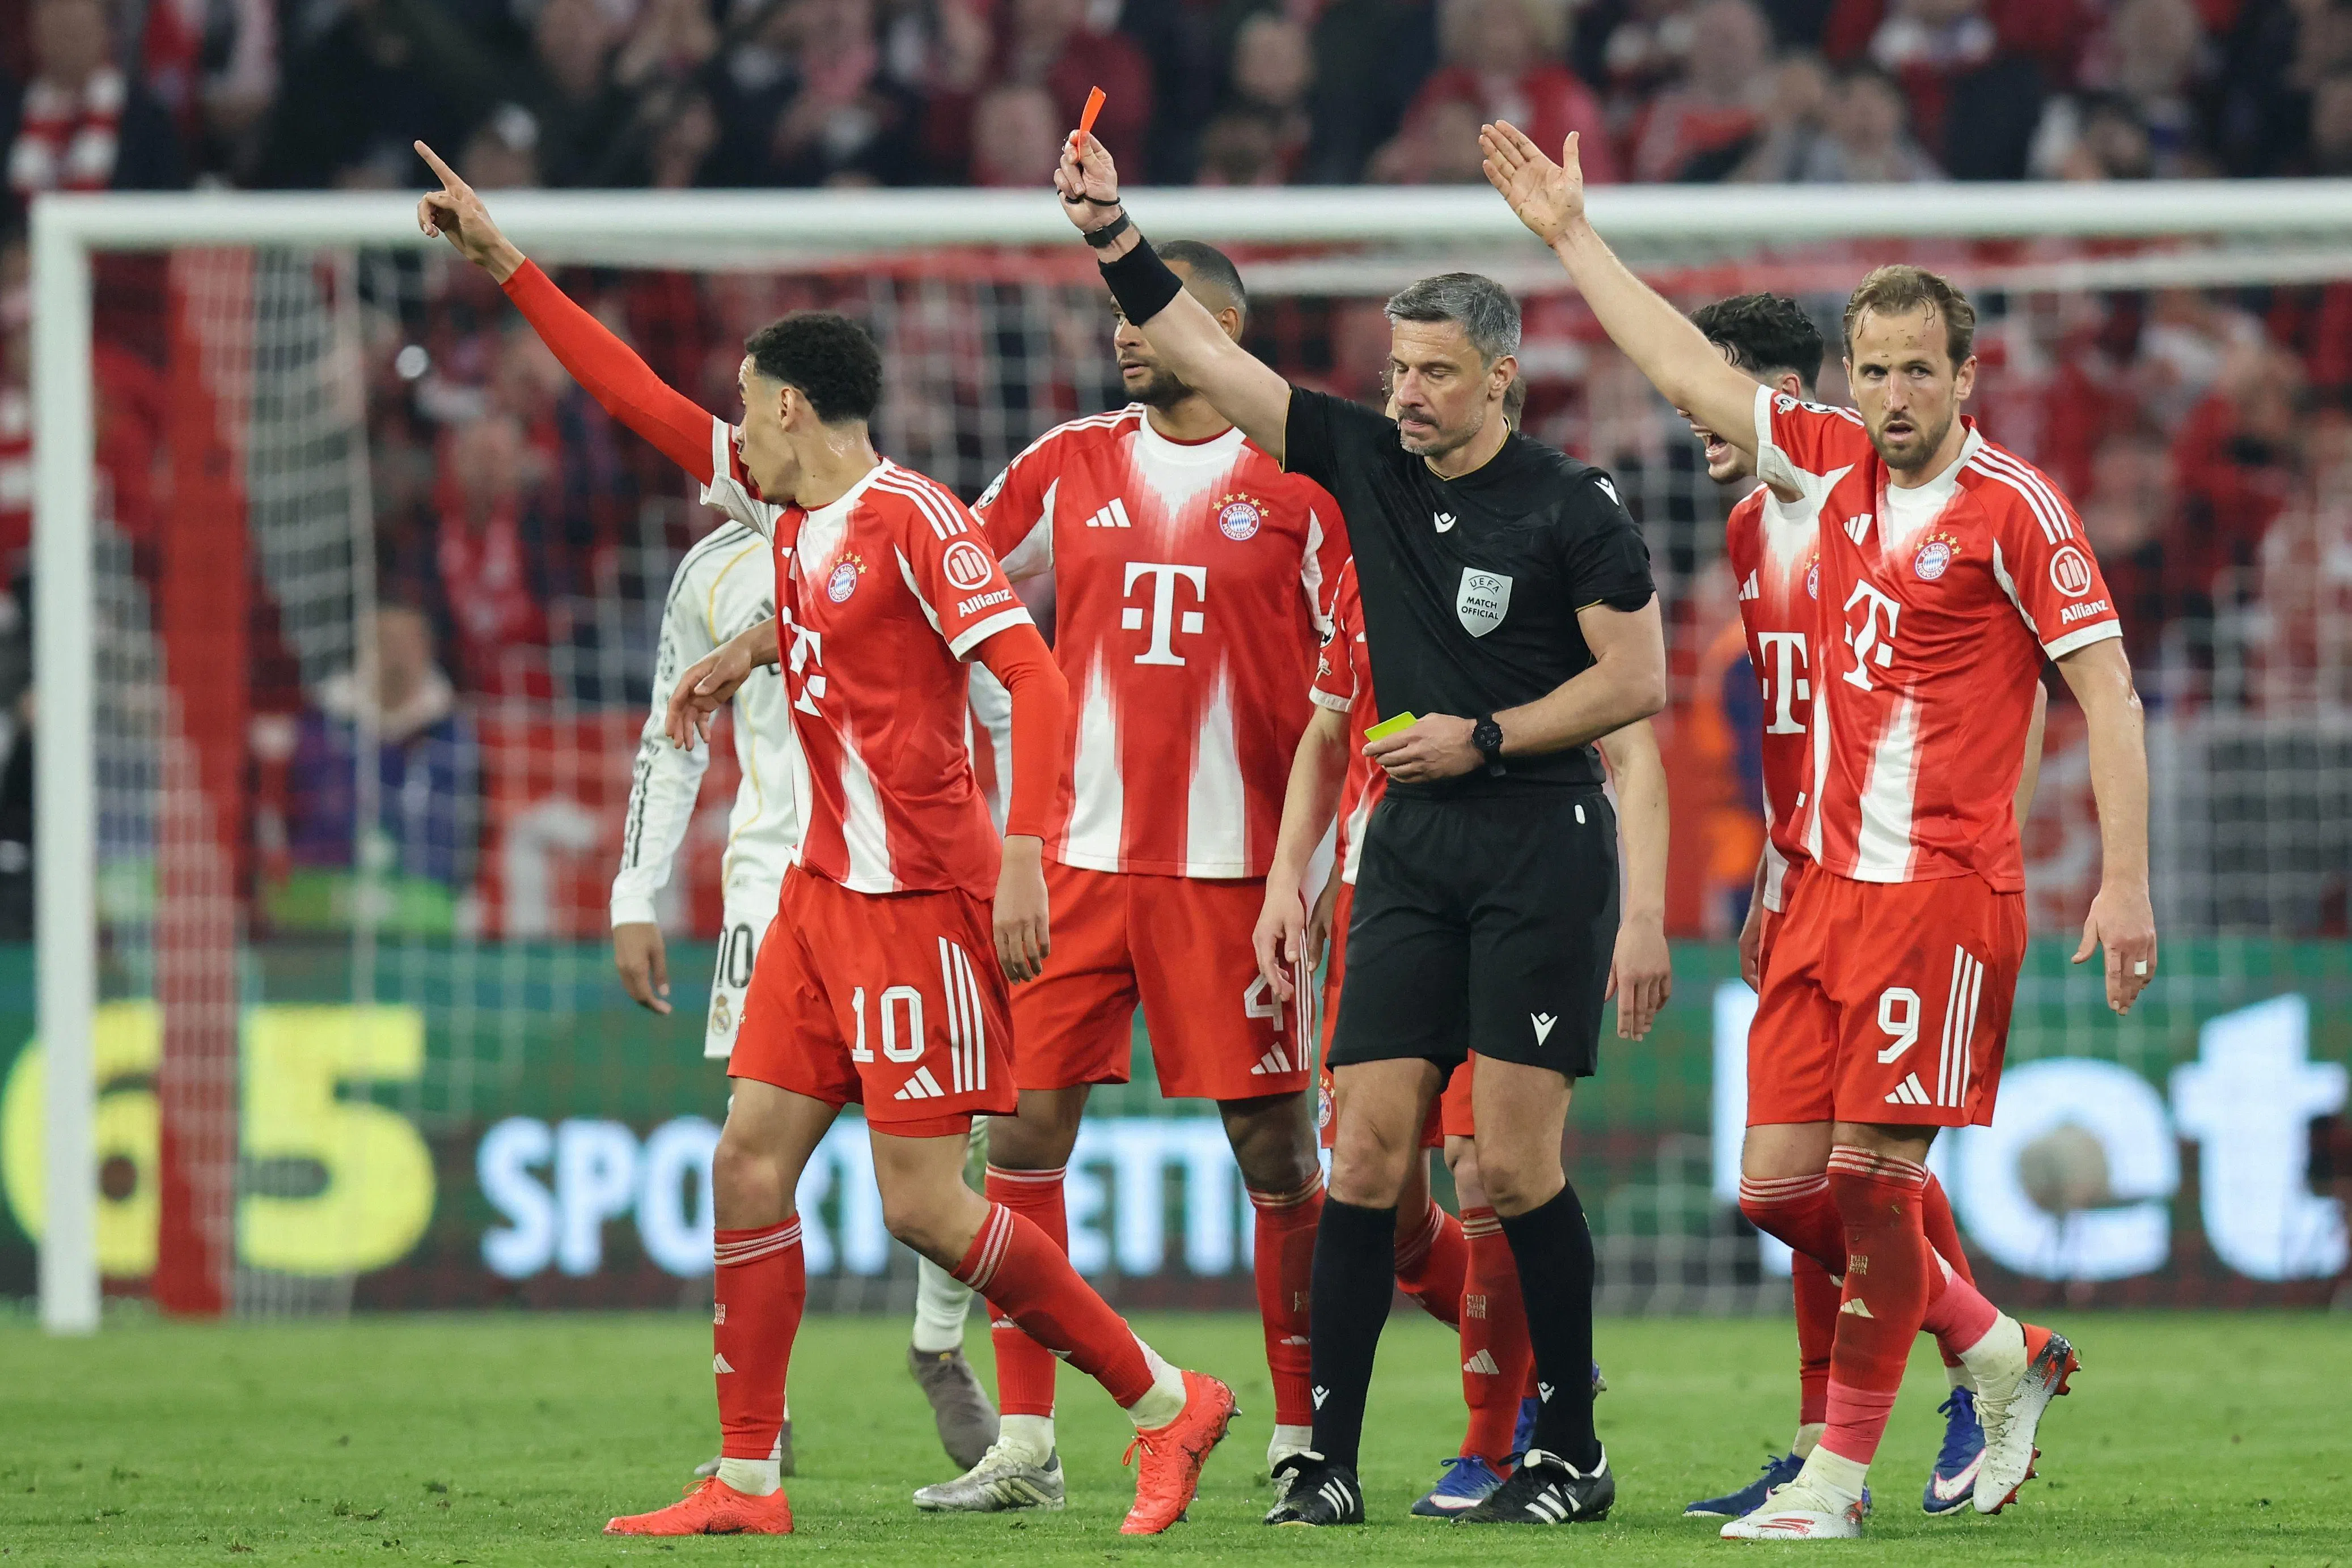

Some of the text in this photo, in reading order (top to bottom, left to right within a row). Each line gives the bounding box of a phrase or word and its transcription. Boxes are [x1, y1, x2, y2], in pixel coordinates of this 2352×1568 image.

[1232, 505, 1257, 521] BAYERN
[957, 588, 1013, 618] Allianz
[1466, 596, 1497, 609] MATCH
[1470, 578, 1500, 592] UEFA
[1122, 562, 1207, 667] T
[1461, 606, 1499, 620] OFFICIAL
[1843, 578, 1900, 692] T
[2059, 599, 2109, 625] Allianz
[1758, 632, 1810, 734] T
[1243, 957, 1284, 1031] 4
[852, 985, 925, 1063] 10
[1877, 987, 1920, 1063] 9
